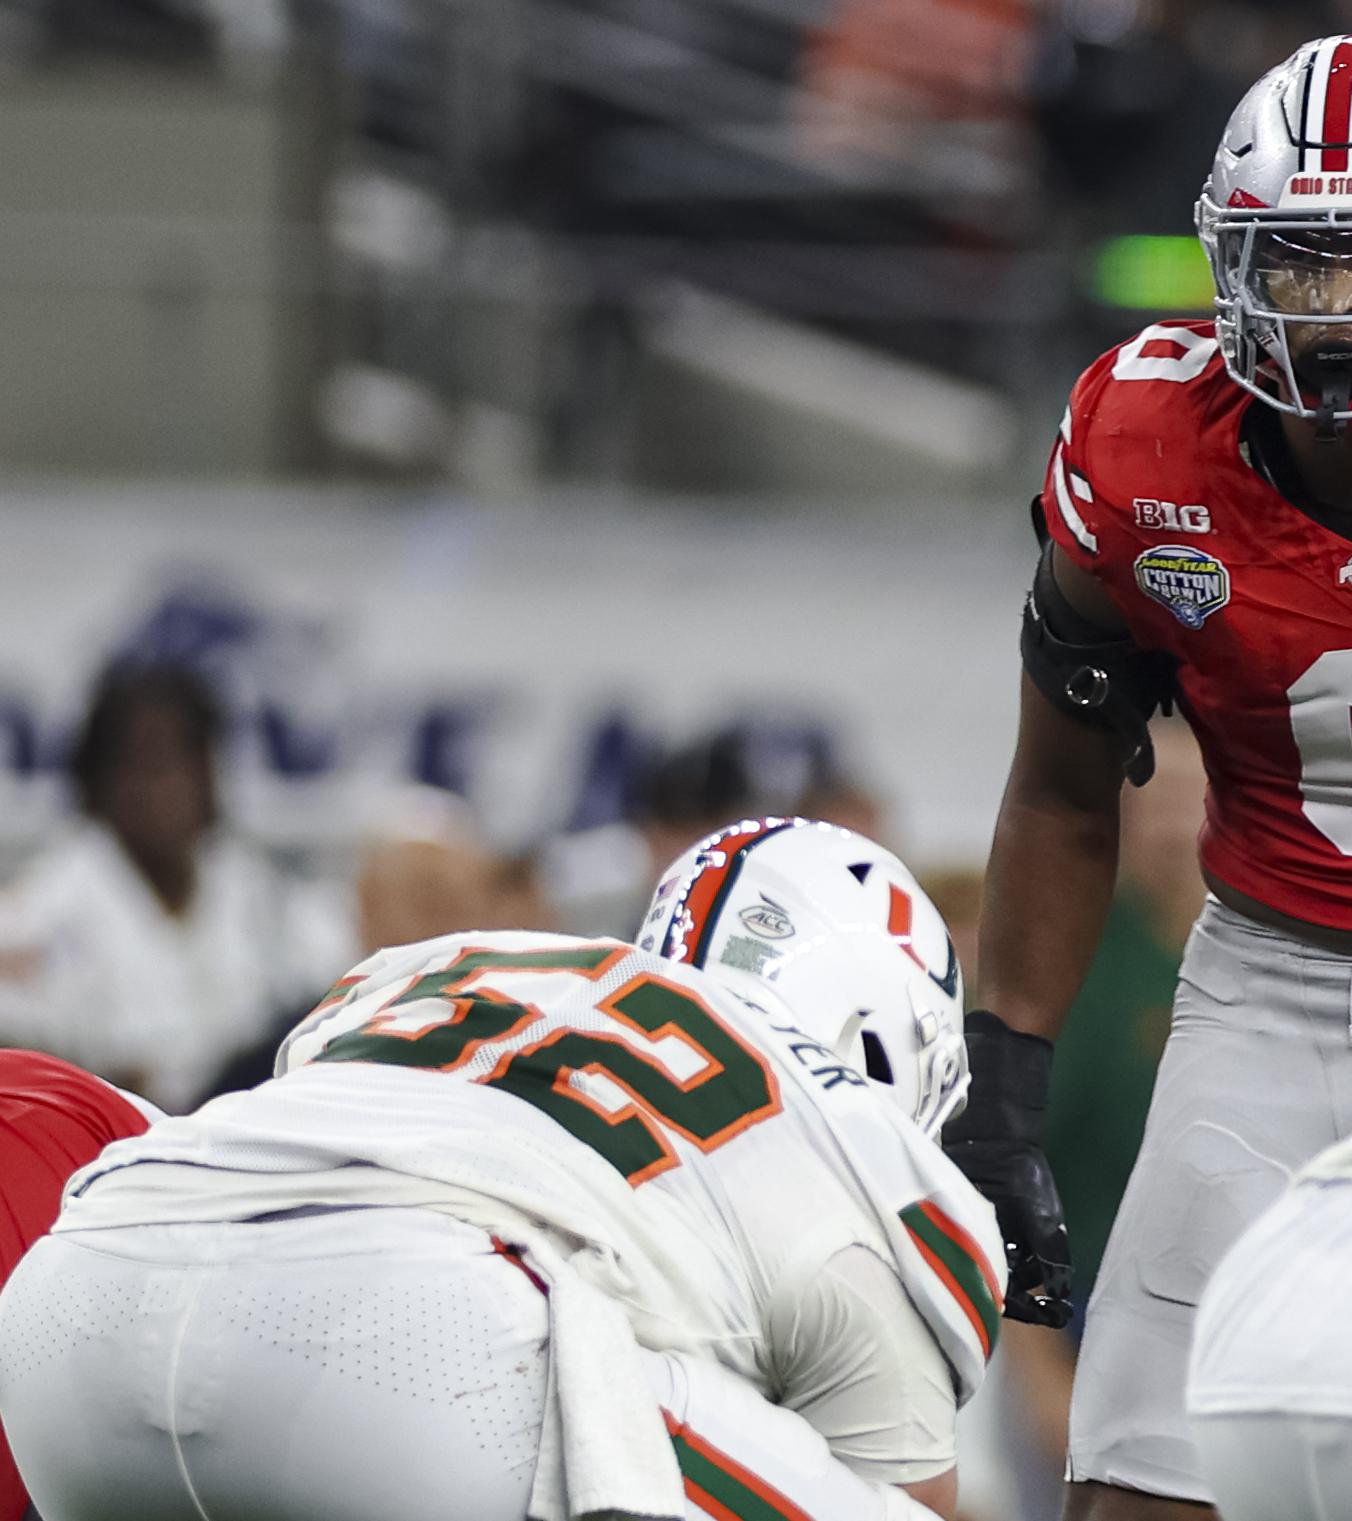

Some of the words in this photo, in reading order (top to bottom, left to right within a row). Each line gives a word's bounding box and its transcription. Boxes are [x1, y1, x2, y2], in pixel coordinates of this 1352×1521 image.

[1290, 177, 1323, 195] OHIO
[1142, 567, 1221, 602] COTTON
[1160, 583, 1207, 604] BOWL
[305, 945, 784, 1189] 52
